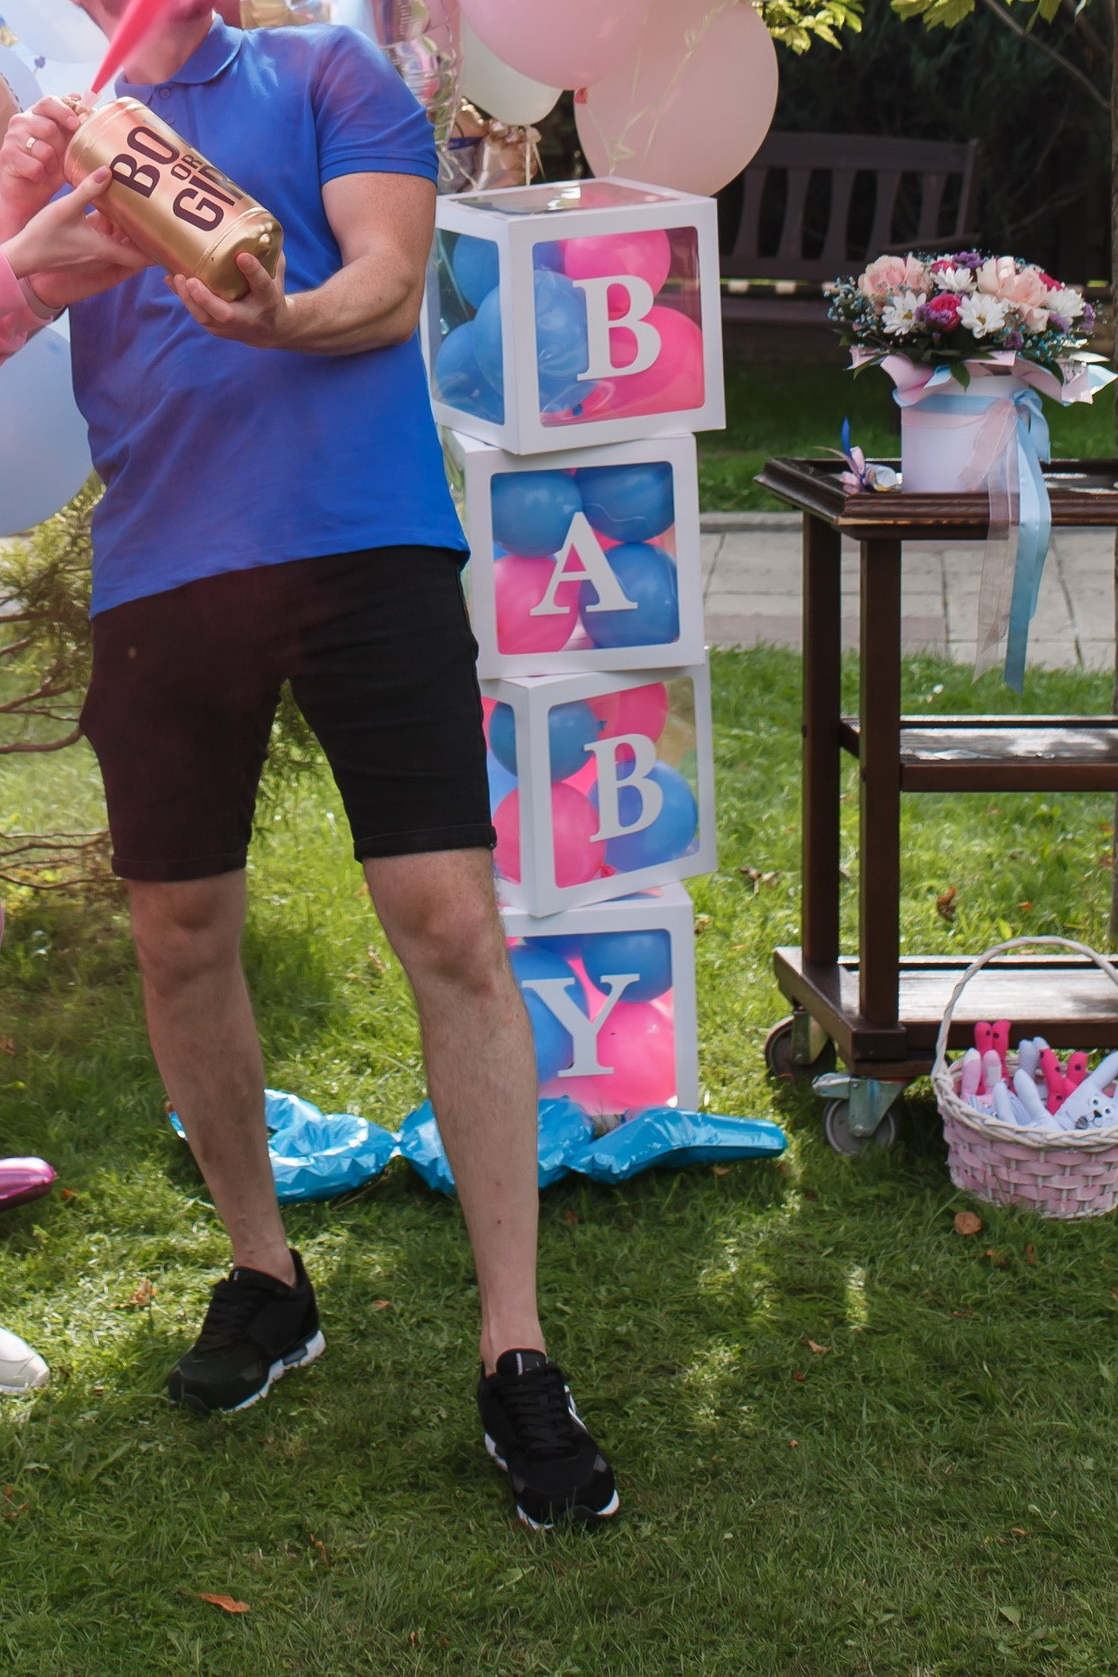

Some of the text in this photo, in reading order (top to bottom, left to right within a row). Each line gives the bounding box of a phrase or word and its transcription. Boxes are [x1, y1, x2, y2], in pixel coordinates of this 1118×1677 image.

[110, 123, 184, 198] BO
[170, 154, 202, 180] OR
[173, 165, 244, 231] GIR
